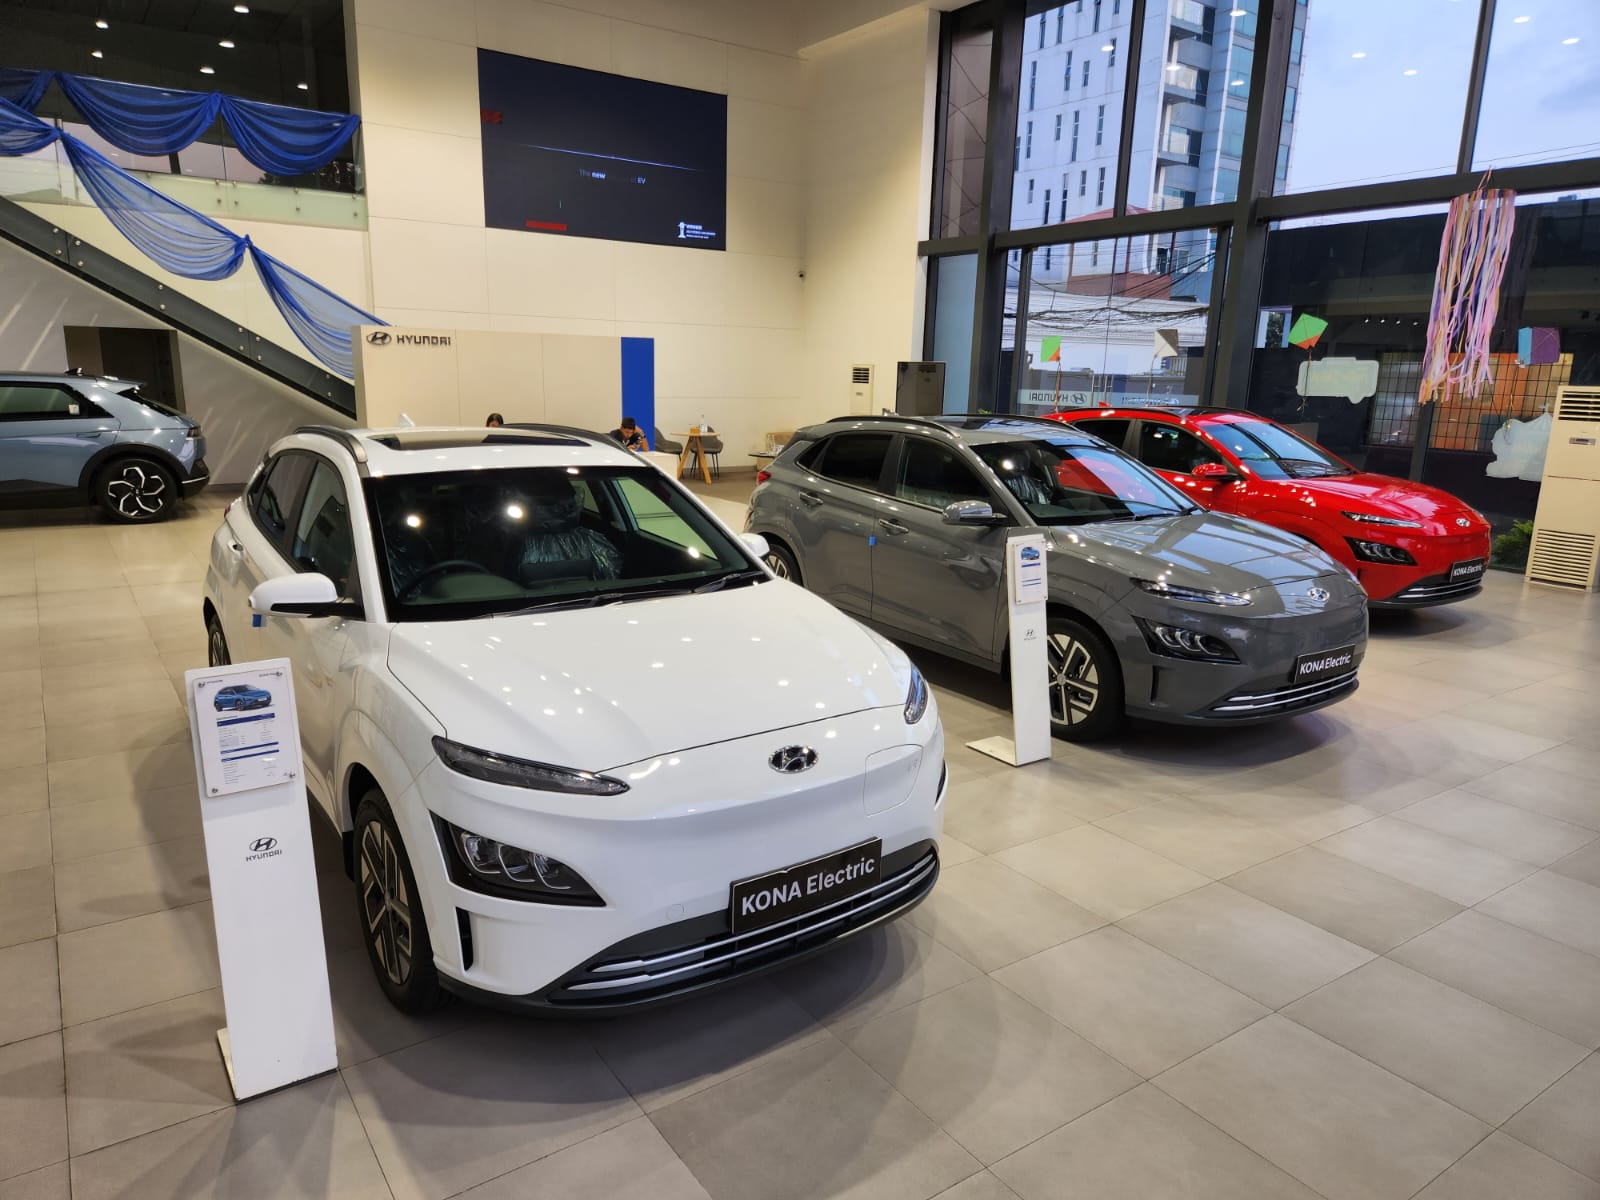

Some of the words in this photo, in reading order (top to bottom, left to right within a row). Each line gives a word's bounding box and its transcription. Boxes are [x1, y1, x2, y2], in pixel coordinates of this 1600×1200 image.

[396, 334, 451, 347] HYUNDAI
[1299, 659, 1325, 676] KONA
[1324, 652, 1352, 670] Electric
[245, 849, 283, 862] HYUNDAI
[741, 880, 802, 916] KONA
[806, 857, 875, 895] Electric
